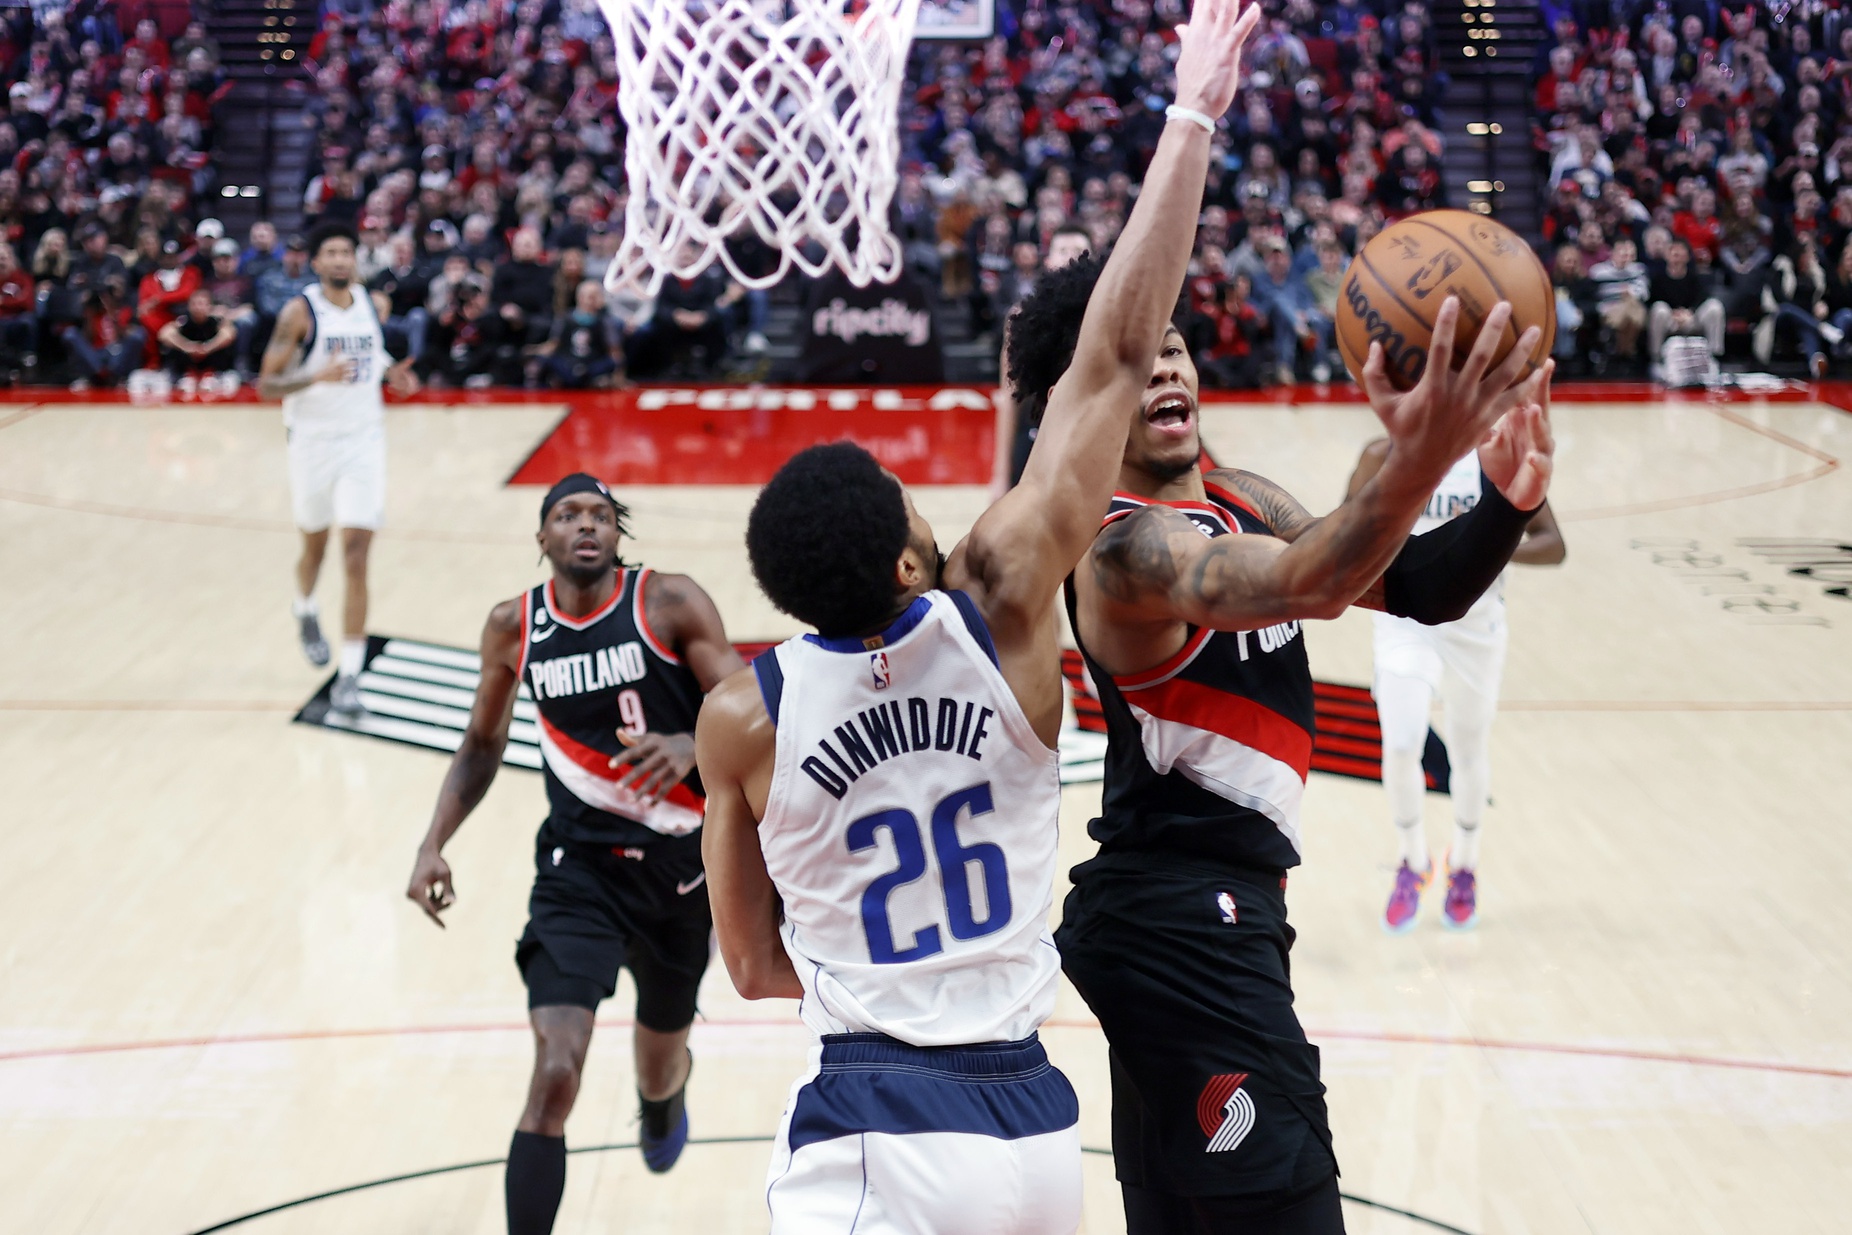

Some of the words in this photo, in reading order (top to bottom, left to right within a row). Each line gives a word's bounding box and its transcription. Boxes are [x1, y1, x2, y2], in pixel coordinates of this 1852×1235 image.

[636, 388, 1003, 412] PORTLA
[529, 641, 648, 701] PORTLAND
[628, 689, 648, 738] 9
[801, 697, 994, 801] DINWIDDIE
[845, 780, 1013, 965] 26
